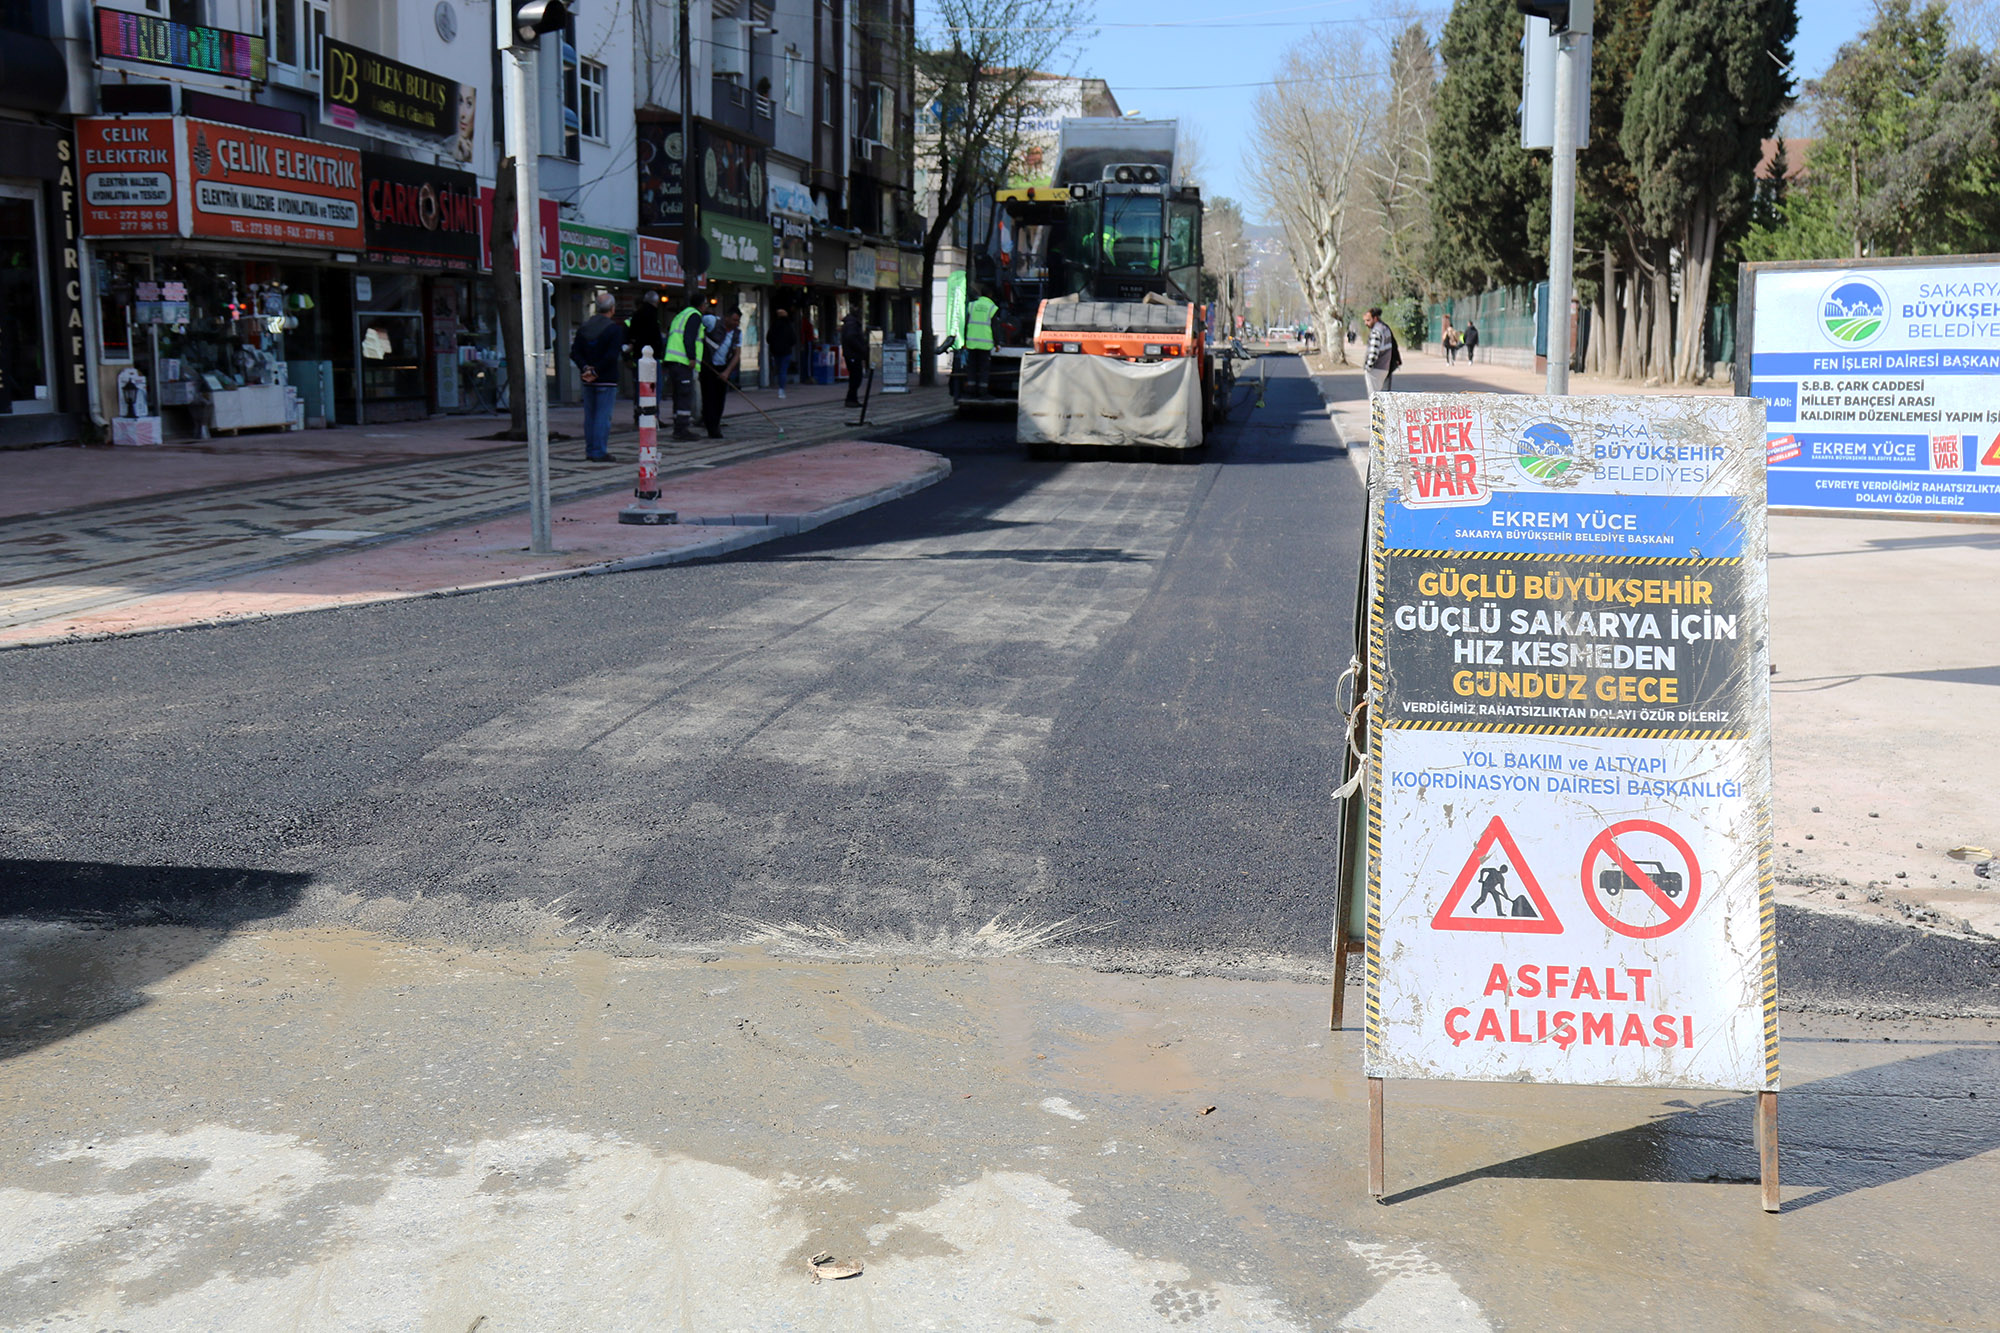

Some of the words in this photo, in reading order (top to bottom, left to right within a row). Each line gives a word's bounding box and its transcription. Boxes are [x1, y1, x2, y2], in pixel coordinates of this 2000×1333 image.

[101, 124, 150, 145] ÇELİK
[85, 146, 169, 165] ELEKTRİK
[217, 136, 271, 177] ÇELİK
[274, 147, 357, 190] ELEKTRİK
[202, 187, 239, 209] ELEKTRİK
[241, 193, 275, 212] MALZEME
[278, 198, 318, 217] AYDINLATMA
[91, 210, 111, 220] TEL
[120, 210, 138, 220] 272
[140, 210, 153, 220] 50
[120, 221, 138, 231] 277
[1920, 282, 2000, 298] SAKARY
[66, 280, 86, 385] CAFE
[1908, 320, 2000, 338] BELEDİYE
[1813, 358, 1839, 370] FEN
[1842, 355, 1882, 371] İŞLERİ
[1886, 353, 1939, 368] DAİRESİ
[1943, 355, 2000, 369] BAŞKAN
[1802, 381, 1834, 391] S.B.B.
[1837, 381, 1869, 392] ÇARK
[1872, 379, 1925, 391] CADDESİ
[1773, 397, 1792, 408] ADI:
[1801, 394, 1841, 406] MİLLET
[1844, 394, 1895, 408] BAHÇESİ
[1898, 396, 1935, 407] ARASI
[1801, 410, 1856, 421] KALDIRIM
[1859, 409, 1942, 422] DÜZENLEMESİ
[1945, 412, 1983, 423] YAPIM
[1407, 421, 1475, 454] EMEK
[1933, 441, 1958, 453] EMEK
[1594, 441, 1725, 464] BÜYÜKŞEHİR
[1813, 442, 1867, 455] EKREM
[1872, 441, 1916, 456] YÜCE
[1934, 453, 1959, 469] VAR
[1410, 453, 1479, 498] VAR
[1594, 464, 1710, 483] BELEDİYESİ
[1815, 480, 1859, 491] ÇEVREYE
[1862, 479, 1919, 492] VERDİĞİMİZ
[1922, 482, 2000, 494] RAHATSIZLIKTA
[1856, 493, 1892, 504] DOLAYI
[1895, 492, 1922, 504] ÖZÜR
[1925, 494, 1965, 506] DİLERİZ
[1492, 510, 1569, 528] EKREM
[1576, 509, 1637, 530] YÜCE
[1455, 529, 1503, 539] SAKARYA
[1506, 529, 1572, 542] BÜYÜKŞEHİR
[1575, 532, 1625, 543] BELEDİYE
[1628, 534, 1674, 545] BAŞKANI
[1418, 568, 1517, 602] GÜÇLÜ
[1524, 572, 1713, 607] BÜYÜKŞEHİR
[1395, 602, 1501, 634] GÜÇLÜ
[1510, 608, 1662, 640] SAKARYA
[1670, 609, 1737, 642] İÇİN
[1453, 640, 1504, 665] HIZ
[1512, 641, 1676, 672] KESMEDEN
[1453, 668, 1589, 701] GÜNDÜZ
[1596, 676, 1679, 703] GECE
[1402, 701, 1476, 715] VERDİĞİMİZ
[1479, 704, 1586, 719] RAHATSIZLIKTAN
[1590, 708, 1636, 722] DOLAYI
[1640, 707, 1675, 722] ÖZÜR
[1678, 708, 1729, 723] DİLERİZ
[1462, 750, 1498, 769] YOL
[1504, 752, 1562, 771] BAKIM
[1569, 758, 1589, 772] ve
[1594, 756, 1666, 774] ALTYAPI
[1391, 769, 1540, 793] KOORDİNASYON
[1547, 775, 1621, 795] DAİRESİ
[1628, 779, 1742, 800] BAŞKANLIĞI
[1482, 963, 1652, 1002] ASFALT
[1444, 1006, 1694, 1051] ÇALIŞMASI
